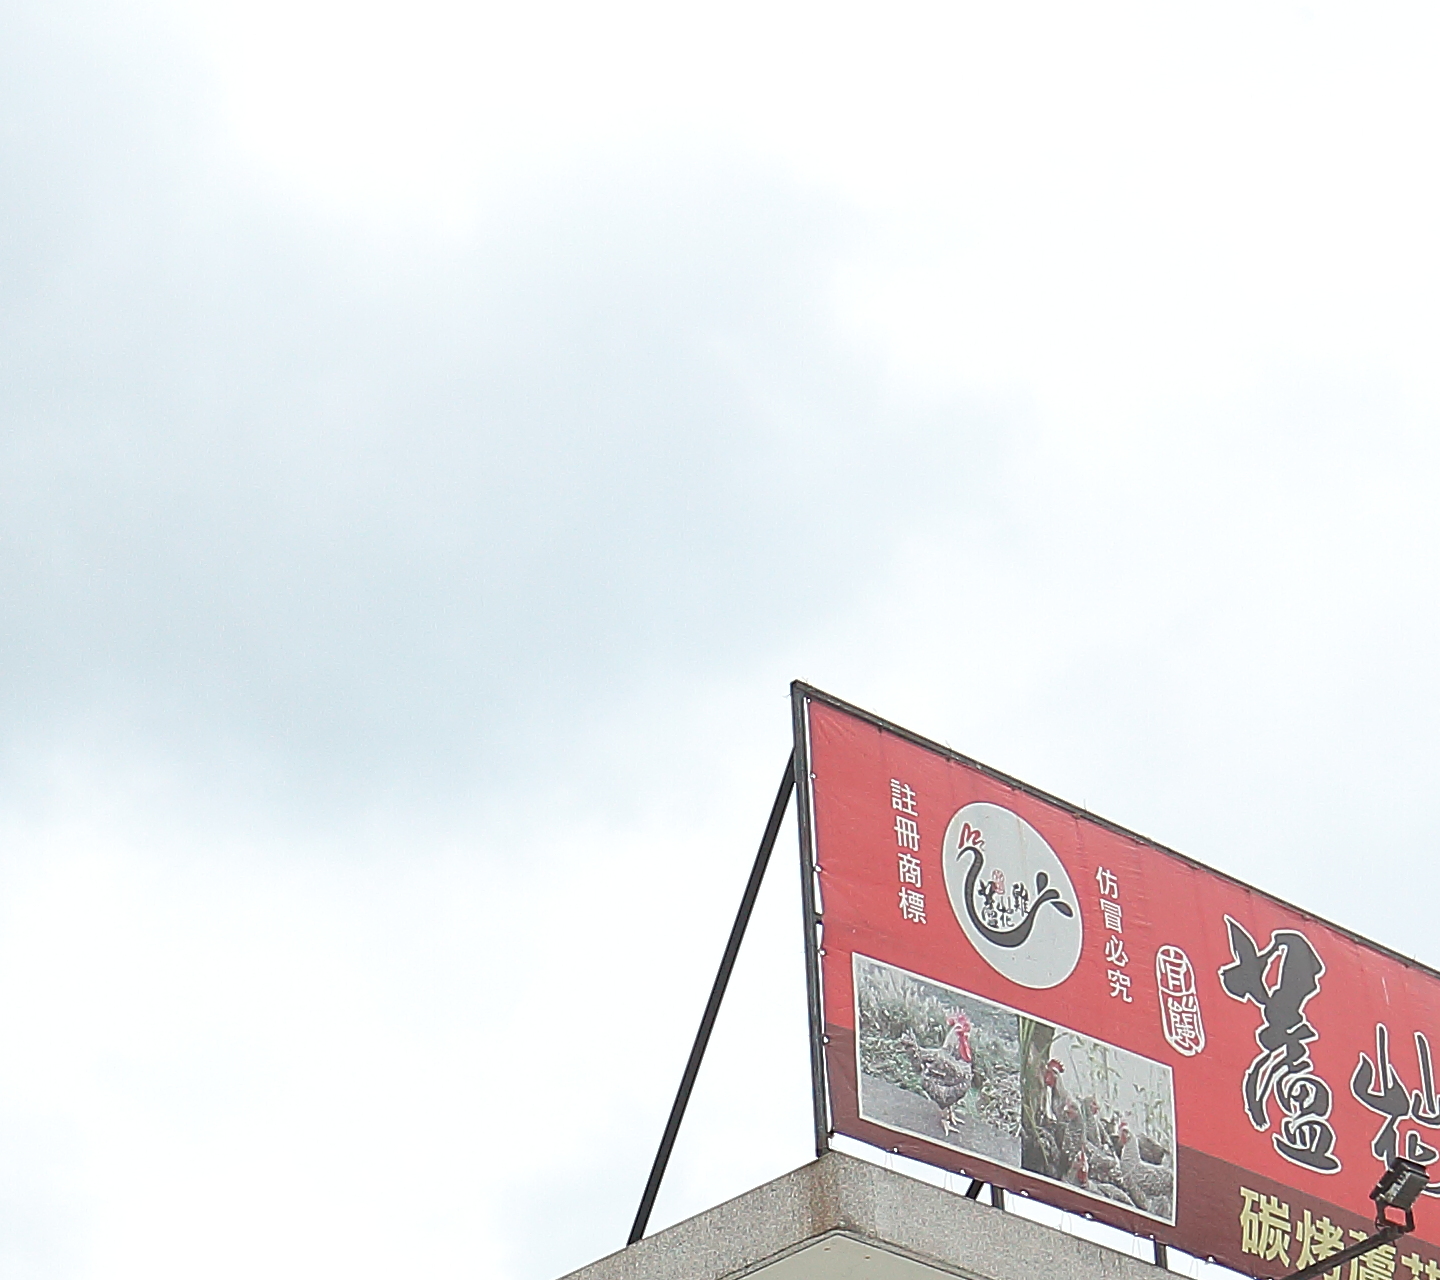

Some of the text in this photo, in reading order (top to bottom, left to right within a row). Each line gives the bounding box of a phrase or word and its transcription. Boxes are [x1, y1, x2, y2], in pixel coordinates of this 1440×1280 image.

[889, 777, 927, 925] 註冊商標
[1095, 865, 1134, 1004] 仿冒必究
